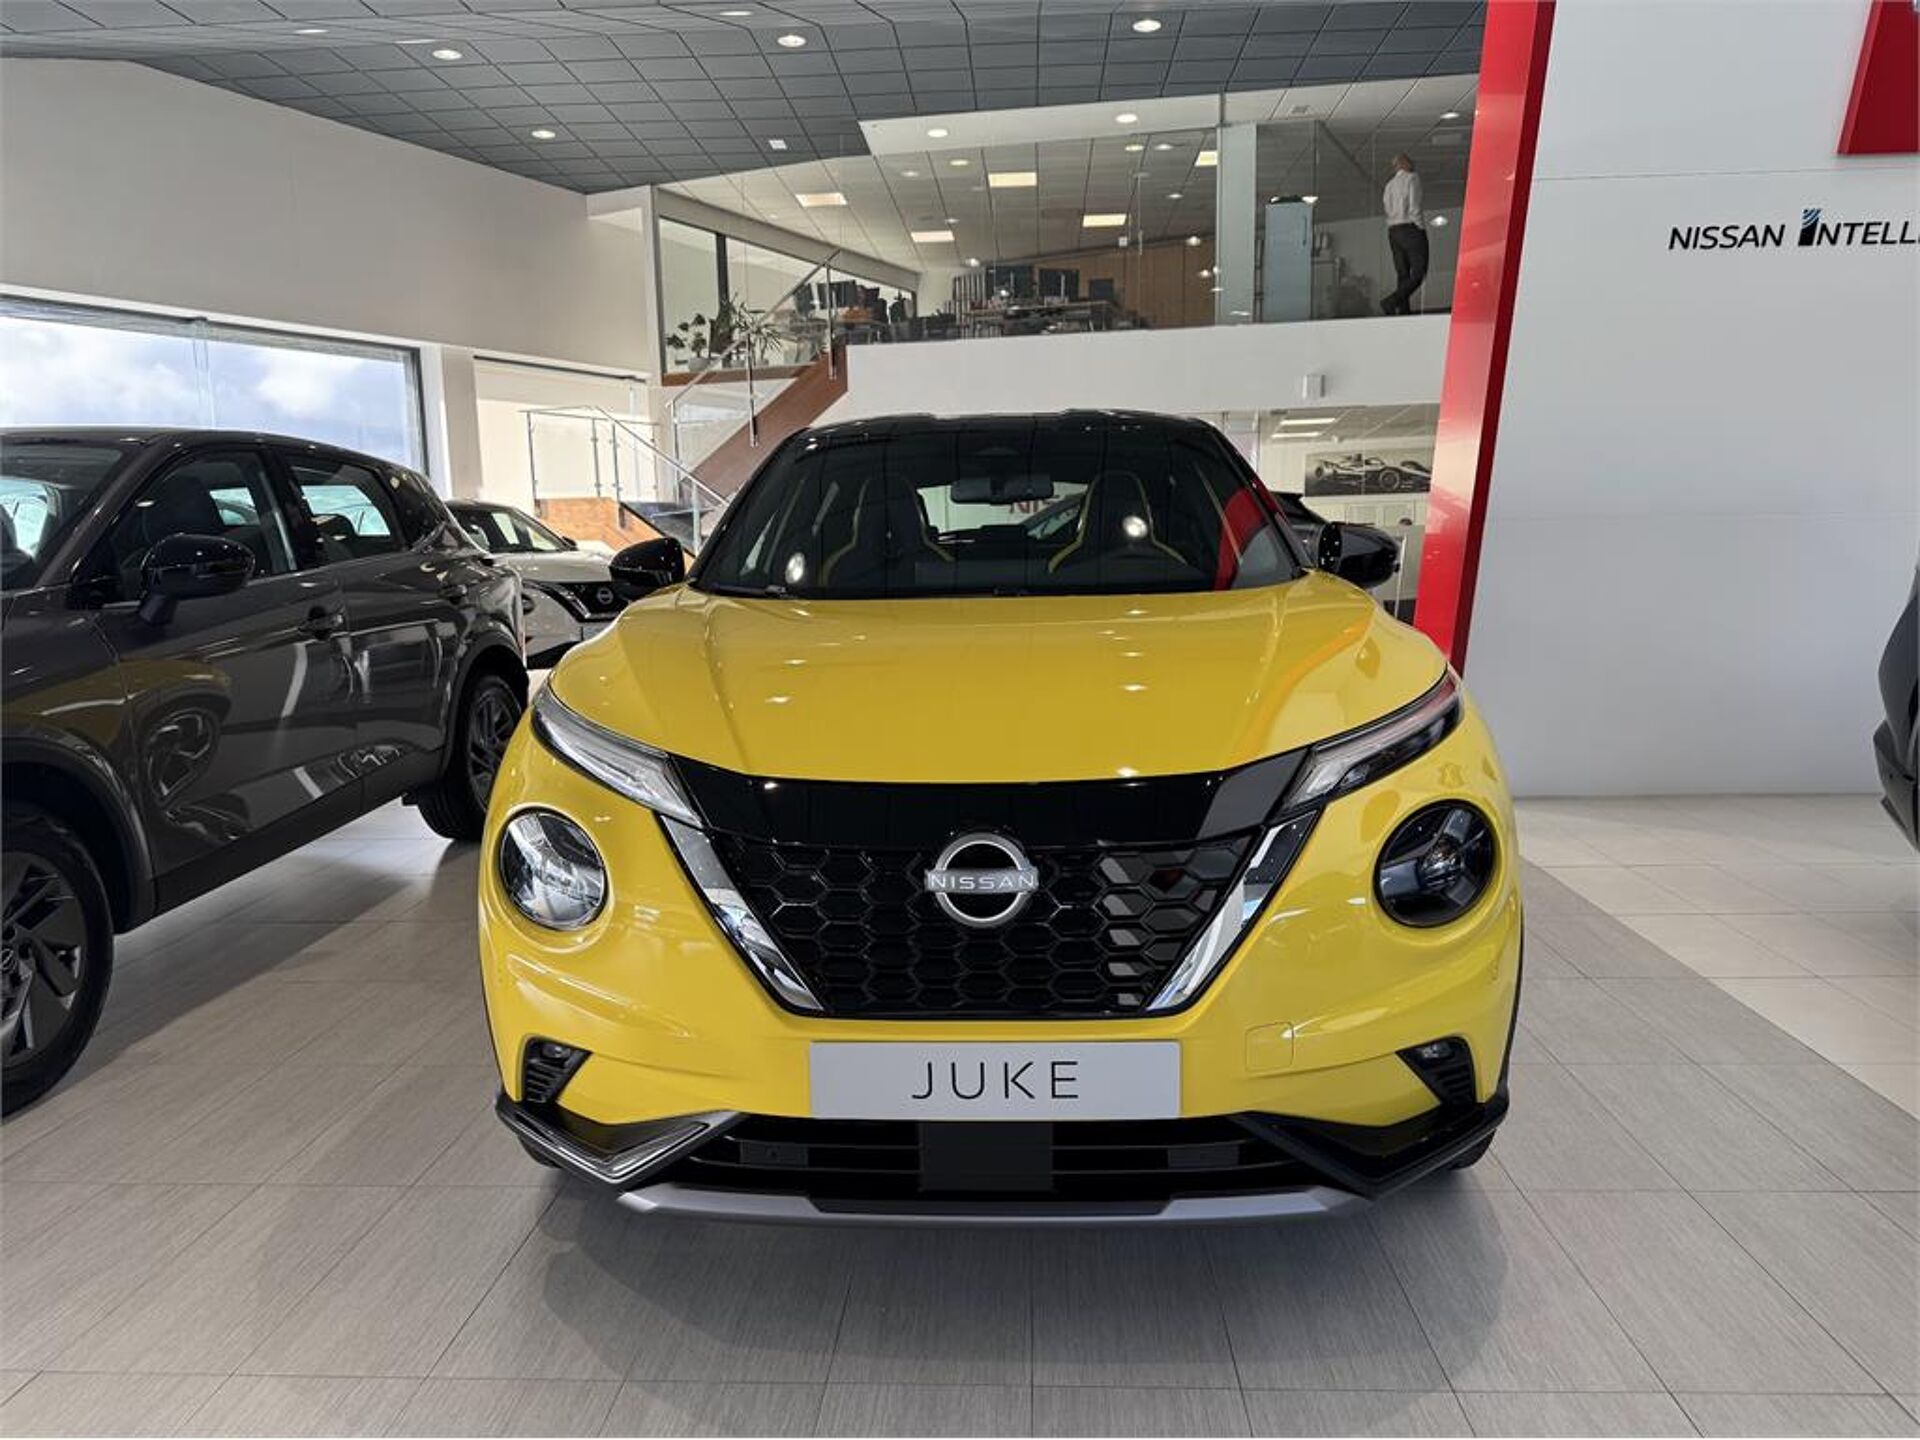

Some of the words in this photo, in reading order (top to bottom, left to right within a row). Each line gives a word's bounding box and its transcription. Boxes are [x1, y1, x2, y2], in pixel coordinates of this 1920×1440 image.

[1668, 224, 1786, 250] NISSAN
[1798, 208, 1920, 247] INTELL
[928, 873, 1036, 890] NISSAN
[911, 1060, 1079, 1100] JUKE
